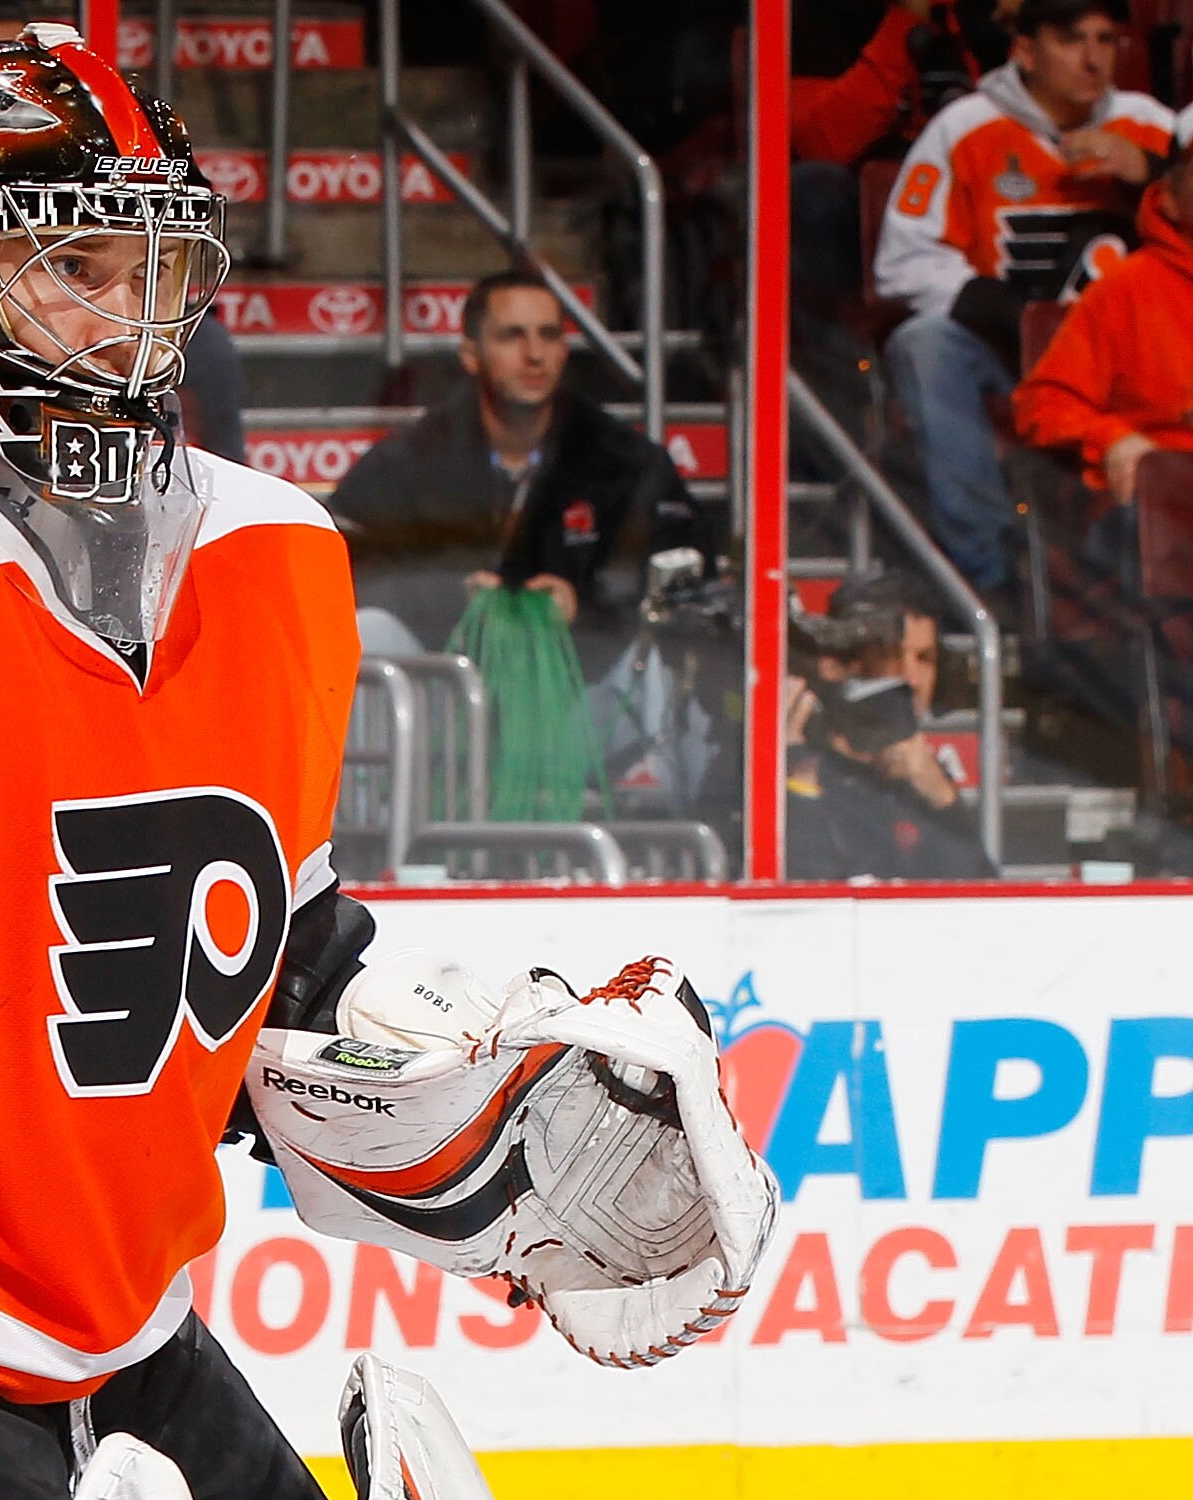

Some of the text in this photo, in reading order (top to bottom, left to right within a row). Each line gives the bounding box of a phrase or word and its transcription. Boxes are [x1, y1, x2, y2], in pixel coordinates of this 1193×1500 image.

[173, 28, 331, 67] OYOA
[94, 156, 189, 177] BAUER
[286, 160, 437, 200] OYOA
[413, 983, 454, 1013] BOBS
[263, 1067, 397, 1119] Reebok
